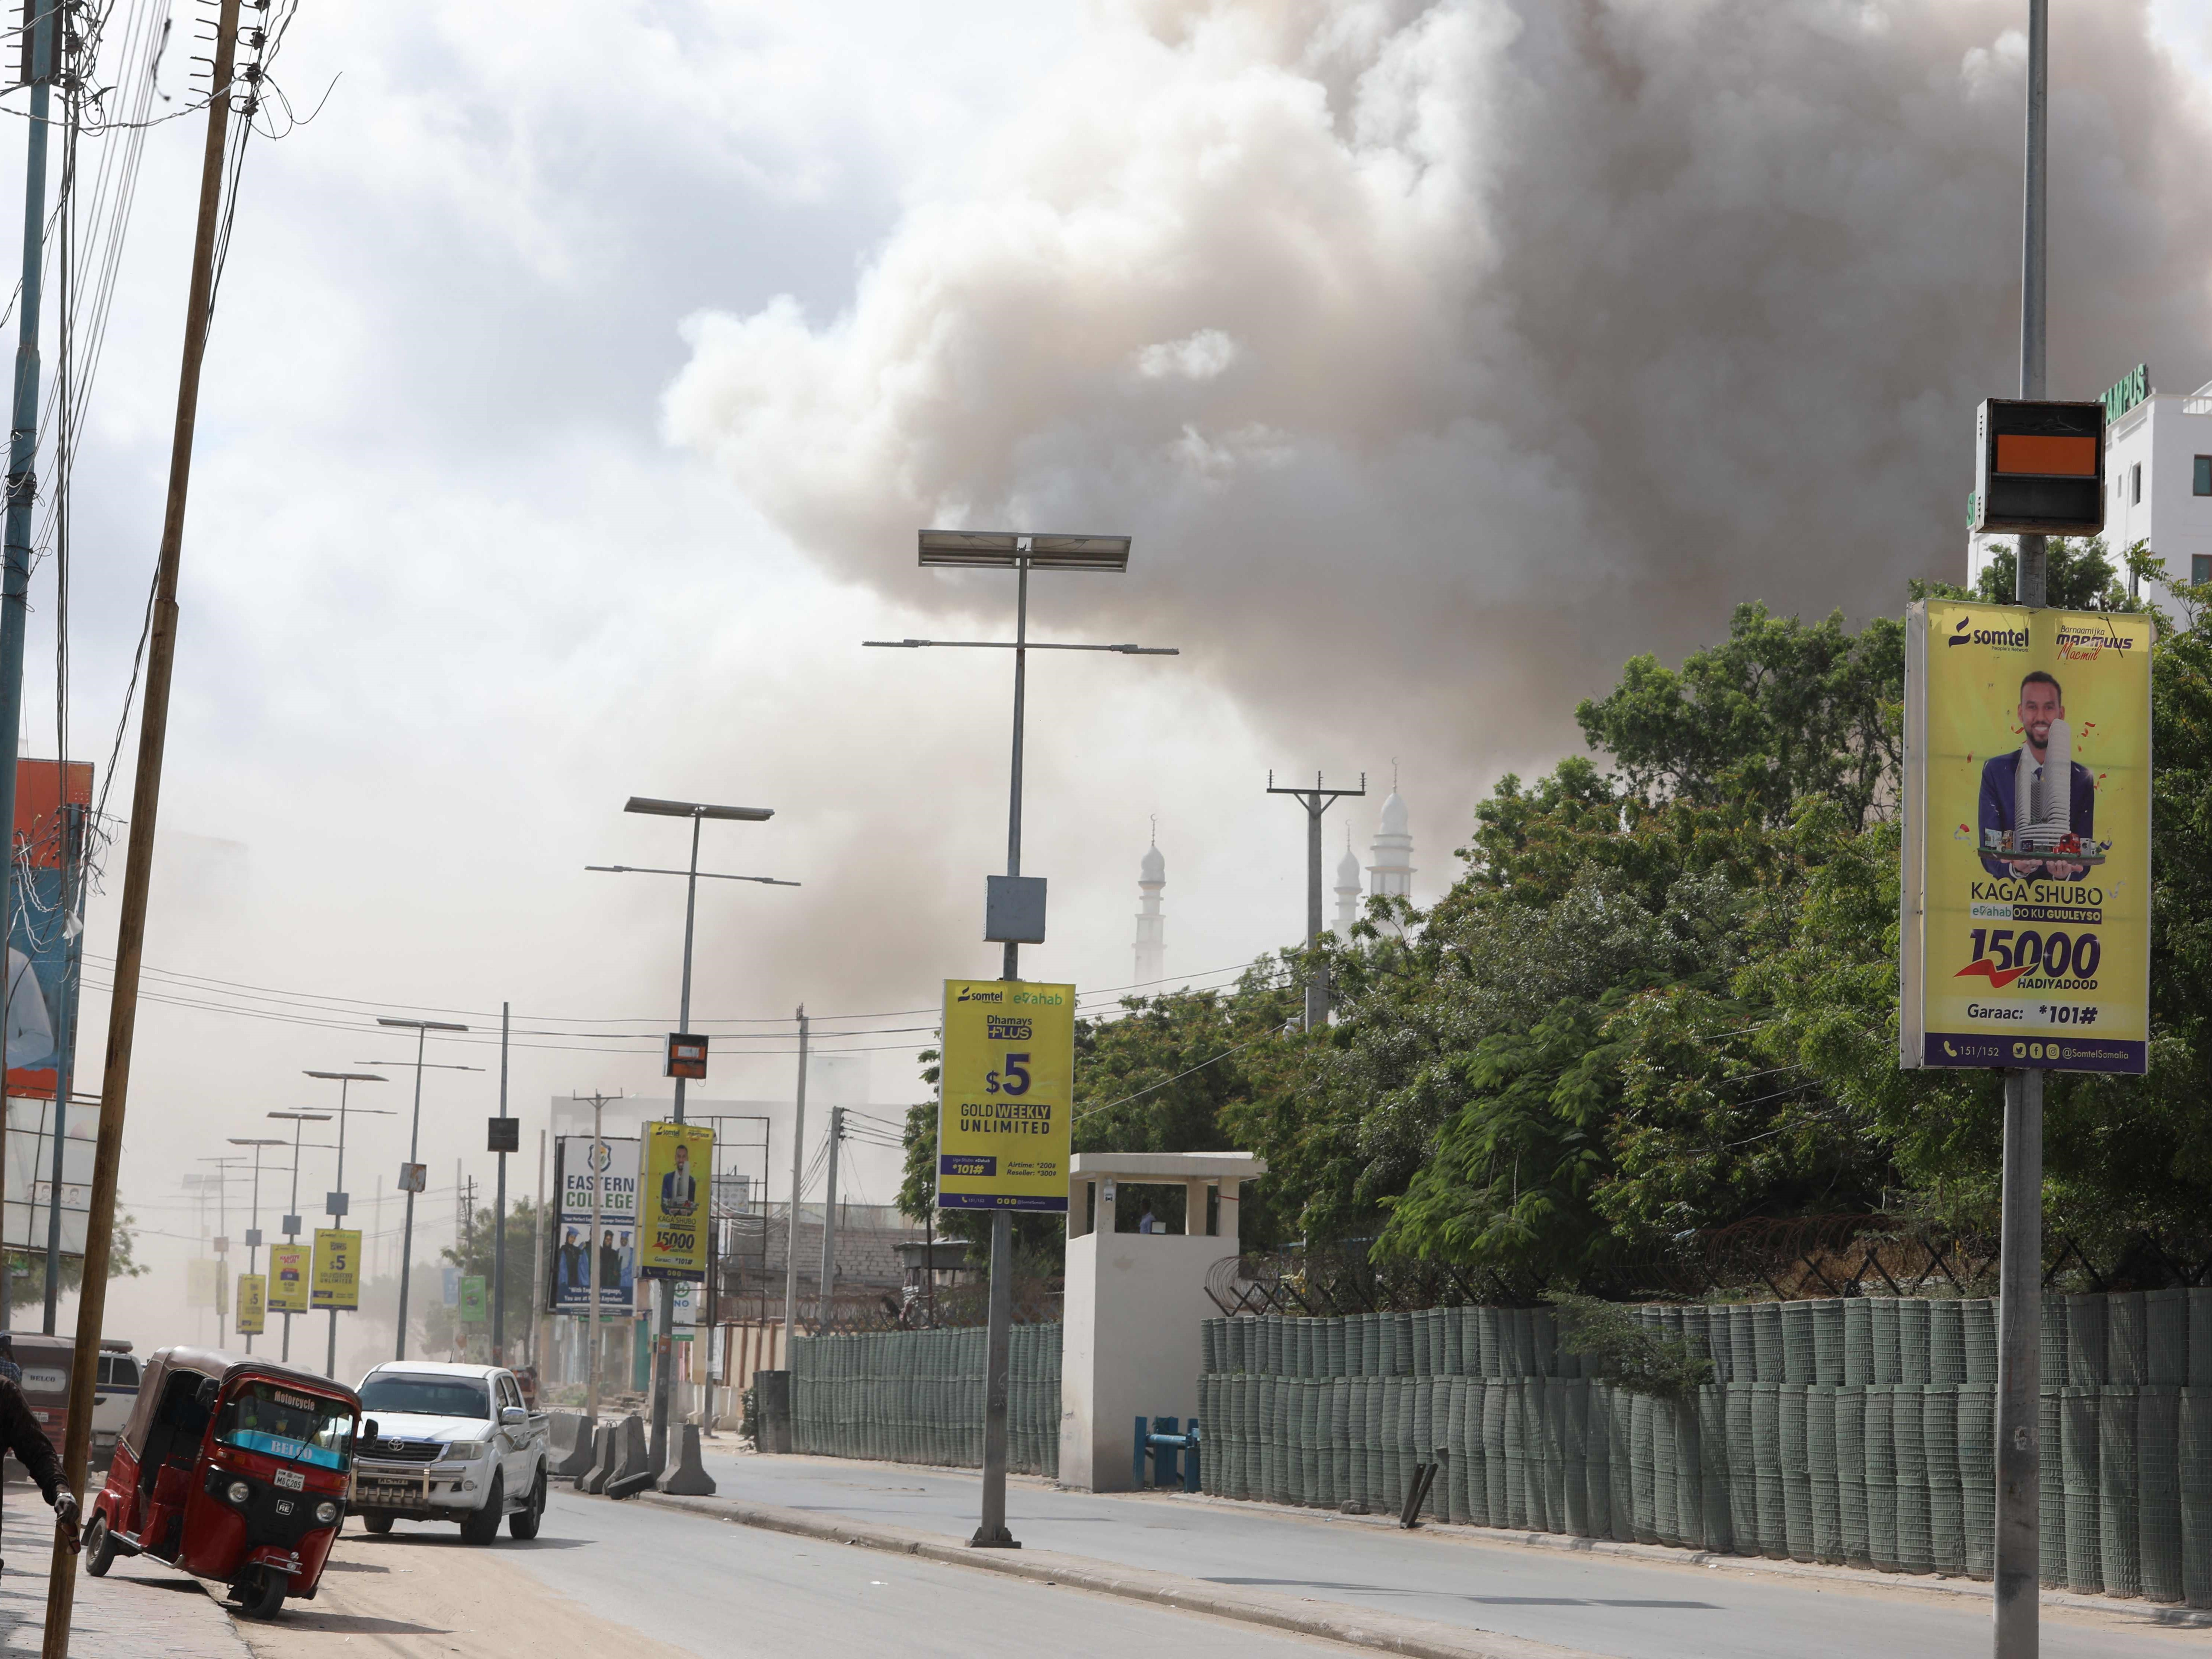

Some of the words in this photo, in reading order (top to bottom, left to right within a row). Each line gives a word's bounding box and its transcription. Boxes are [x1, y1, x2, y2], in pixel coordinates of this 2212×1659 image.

[1974, 628, 2029, 647] somtel
[2061, 625, 2105, 636] Barnaamijka
[1972, 882, 2028, 902] KAGA
[2035, 885, 2103, 905] SHUBO
[2031, 908, 2045, 918] KU
[2047, 909, 2101, 921] GUULEYSO
[1970, 929, 2101, 979] 15000
[2017, 978, 2098, 990] HADIYADOOD
[972, 991, 1002, 1001] somtel
[1967, 1004, 2024, 1019] Garaac:
[987, 1015, 1032, 1026] Dhamays
[1960, 1046, 1999, 1058] 151/152
[2062, 1047, 2129, 1059] @SomtelSomalia
[985, 1054, 1031, 1096] $5
[961, 1104, 993, 1117] GOLD
[997, 1105, 1049, 1119] WEEKLY
[961, 1119, 1050, 1134] UNLIMITED
[568, 1175, 634, 1192] EASERN
[567, 1192, 633, 1209] COLEGE
[675, 1216, 696, 1225] SHUBO
[657, 1231, 695, 1249] 15000
[274, 1390, 315, 1411] Motorcycle
